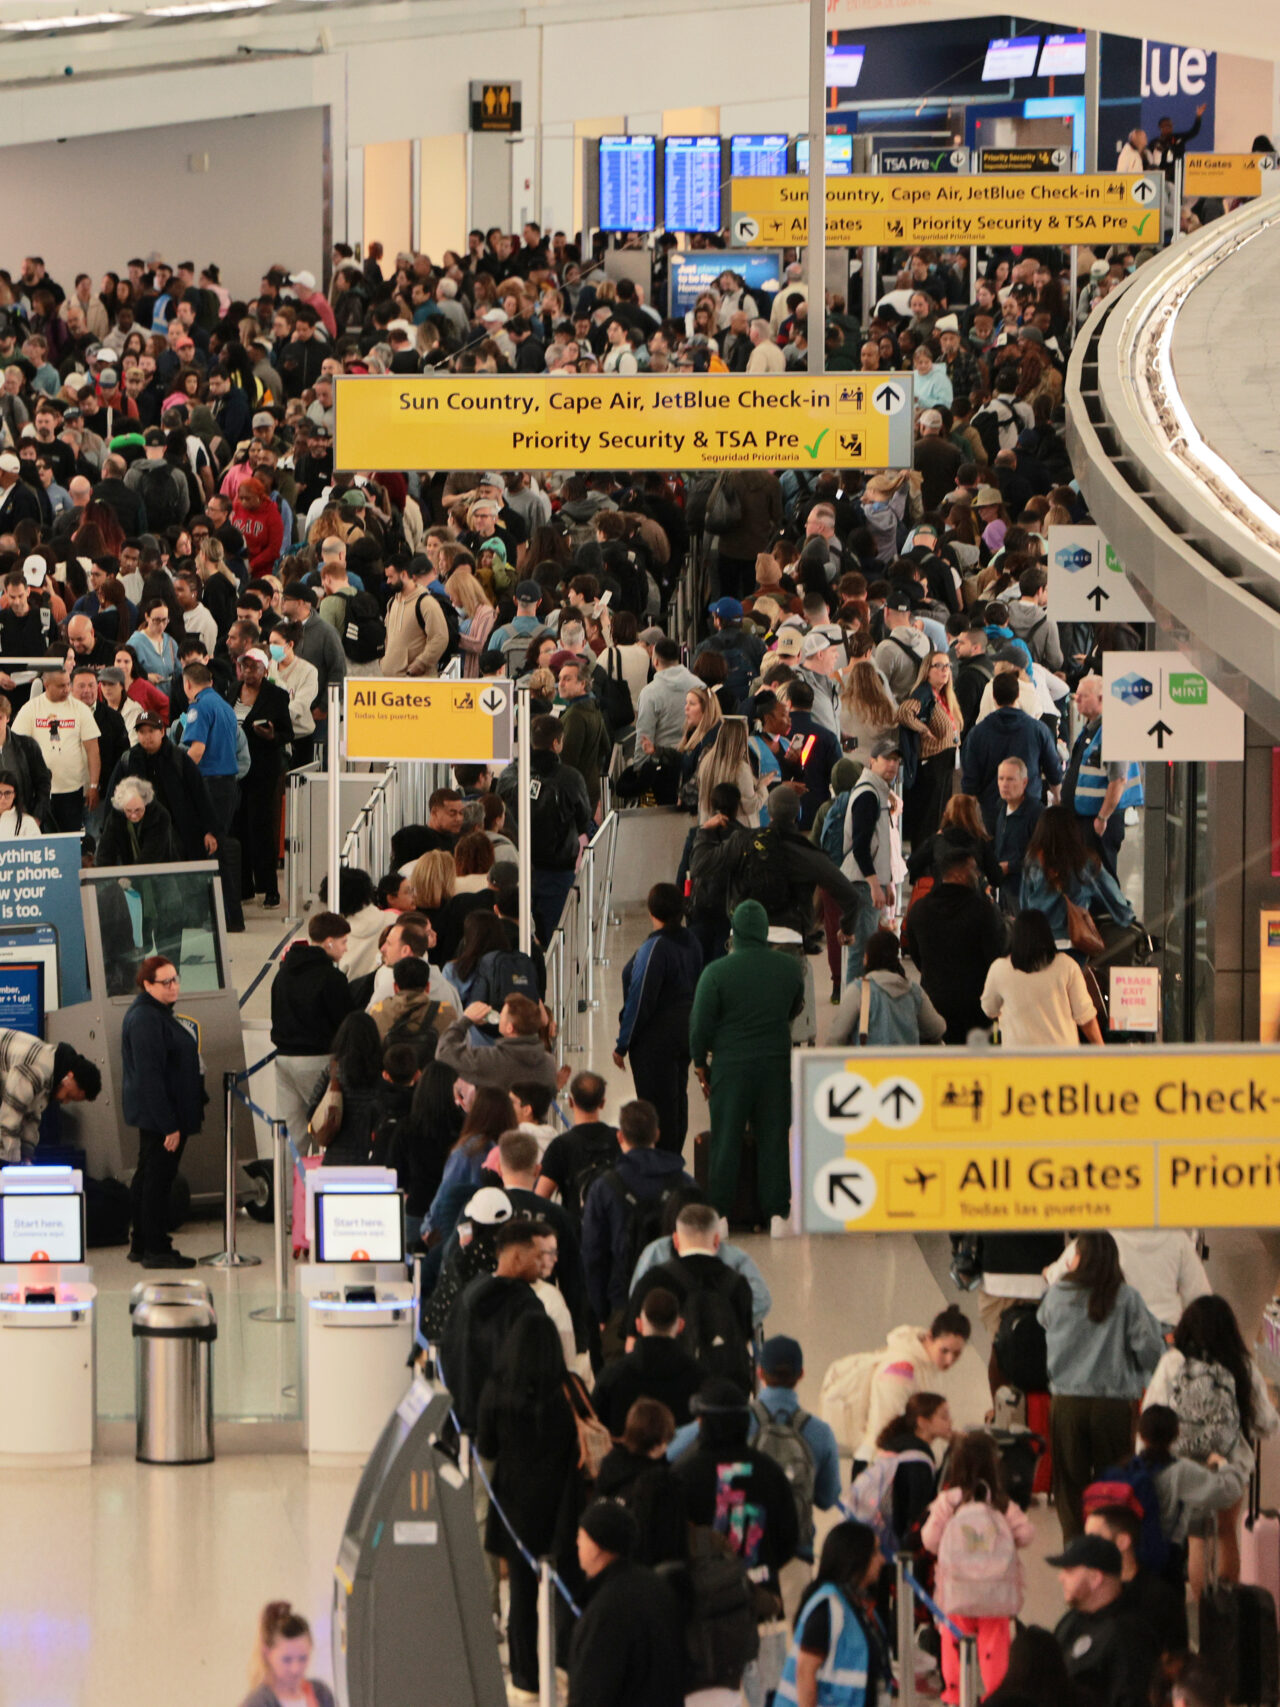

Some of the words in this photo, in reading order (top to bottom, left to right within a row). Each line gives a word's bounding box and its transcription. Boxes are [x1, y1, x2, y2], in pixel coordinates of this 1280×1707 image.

[884, 157, 908, 172] TSA
[909, 157, 930, 171] Pre
[1188, 159, 1202, 169] All
[1204, 159, 1232, 169] Gates
[780, 187, 809, 202] Sun
[825, 188, 884, 204] ountry,
[891, 187, 931, 204] Cape
[936, 187, 963, 202] Air,
[966, 186, 1025, 201] JetBlue
[1031, 184, 1100, 200] Check-in
[791, 217, 808, 230] Al
[825, 217, 862, 230] ates
[912, 215, 972, 232] Priority
[977, 214, 1043, 232] Security
[1048, 215, 1060, 229] &
[1064, 215, 1097, 229] TSA
[1102, 214, 1128, 229] Pre
[399, 393, 439, 410] Sun
[447, 393, 540, 414] Country,
[549, 393, 602, 414] Cape
[610, 391, 645, 411] Air,
[652, 391, 730, 409] JetBlue
[738, 389, 830, 408] Check-in
[512, 430, 591, 453] Priority
[599, 430, 685, 453] Security
[693, 430, 709, 448] &
[716, 430, 757, 448] TSA
[765, 430, 799, 448] Pre
[701, 453, 750, 463] Seguridad
[752, 452, 800, 462] Prioritaria
[353, 691, 377, 706] All
[381, 692, 432, 707] Gates
[1171, 686, 1205, 698] MINT
[354, 712, 375, 720] Todas
[377, 712, 388, 720] las
[390, 713, 419, 721] puertas
[44, 846, 56, 862] is
[16, 866, 63, 885] phone.
[13, 885, 46, 904] your
[2, 905, 14, 919] is
[16, 904, 42, 918] too.
[1115, 975, 1153, 986] PLEASE
[17, 994, 31, 1004] up!
[1122, 987, 1144, 996] EXIT
[1001, 1083, 1140, 1116] JetBlue
[960, 1159, 1011, 1191] All
[1028, 1159, 1141, 1191] Gates
[960, 1202, 1009, 1217] Todas
[1015, 1202, 1039, 1217] las
[1044, 1202, 1111, 1220] puertas
[14, 1218, 39, 1229] Start
[334, 1217, 359, 1228] Start
